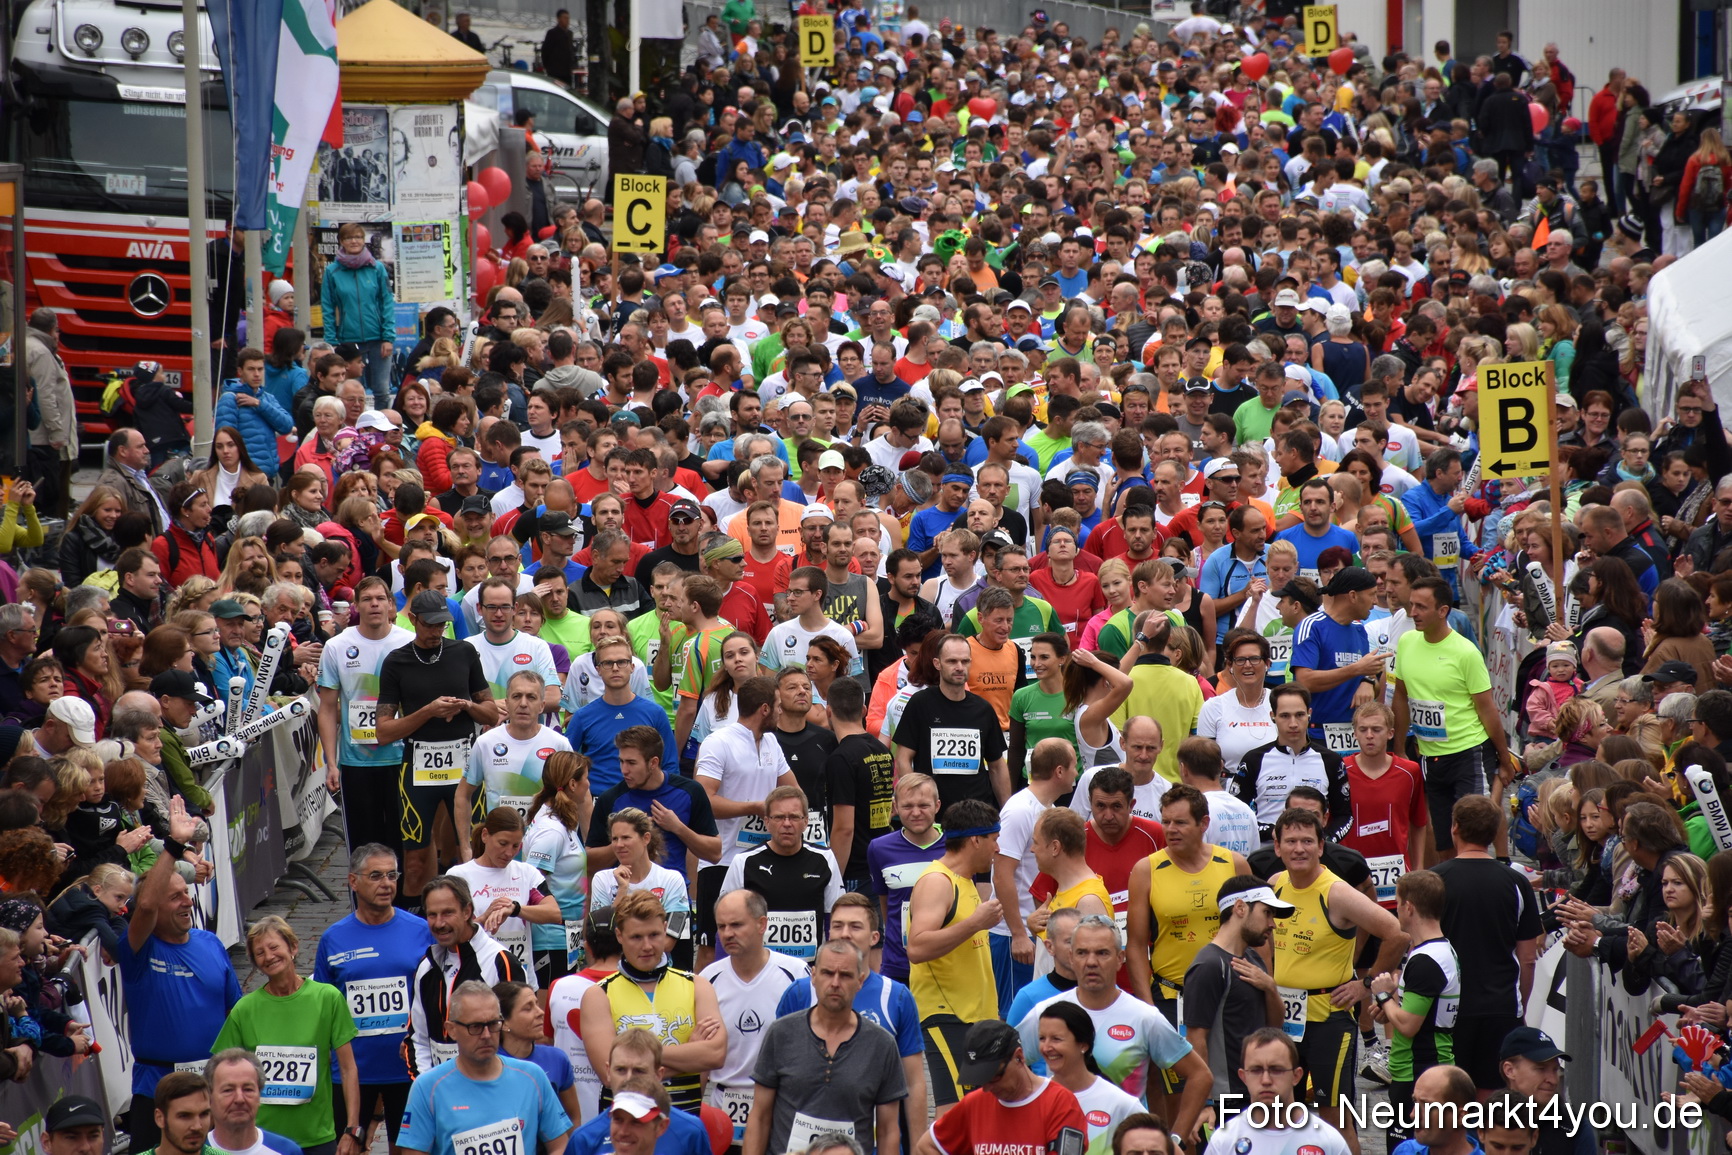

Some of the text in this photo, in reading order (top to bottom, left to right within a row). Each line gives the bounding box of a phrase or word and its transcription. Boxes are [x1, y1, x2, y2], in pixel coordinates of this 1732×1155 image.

[1308, 8, 1334, 18] Block
[803, 18, 829, 28] Block
[1314, 21, 1331, 45] D
[808, 31, 825, 55] D
[108, 177, 144, 190] BANFF
[620, 177, 660, 193] Block
[626, 198, 653, 236] C
[1486, 366, 1546, 390] Block
[1498, 397, 1538, 454] B
[1536, 582, 1551, 605] BMW
[257, 654, 273, 688] BMW
[1411, 707, 1441, 726] 2780
[936, 739, 977, 757] 2236
[423, 751, 454, 769] 264
[943, 760, 970, 769] Andreas
[429, 772, 449, 781] Georg
[1706, 799, 1729, 832] BMW
[1171, 917, 1189, 926] Seidl
[767, 923, 812, 944] 2063
[368, 982, 397, 990] Neumarkt
[353, 990, 404, 1015] 3109
[359, 1016, 391, 1028] Ernst
[1111, 1028, 1132, 1037] Hervis
[261, 1060, 312, 1083] 2287
[265, 1086, 302, 1097] Gabriele
[724, 1092, 742, 1100] PARTL
[795, 1118, 846, 1135] PARTL Neumarkt
[1088, 1113, 1109, 1124] Hervis
[455, 1127, 510, 1147] PARTL Neumarkt
[974, 1143, 1034, 1155] NEUMARKT
